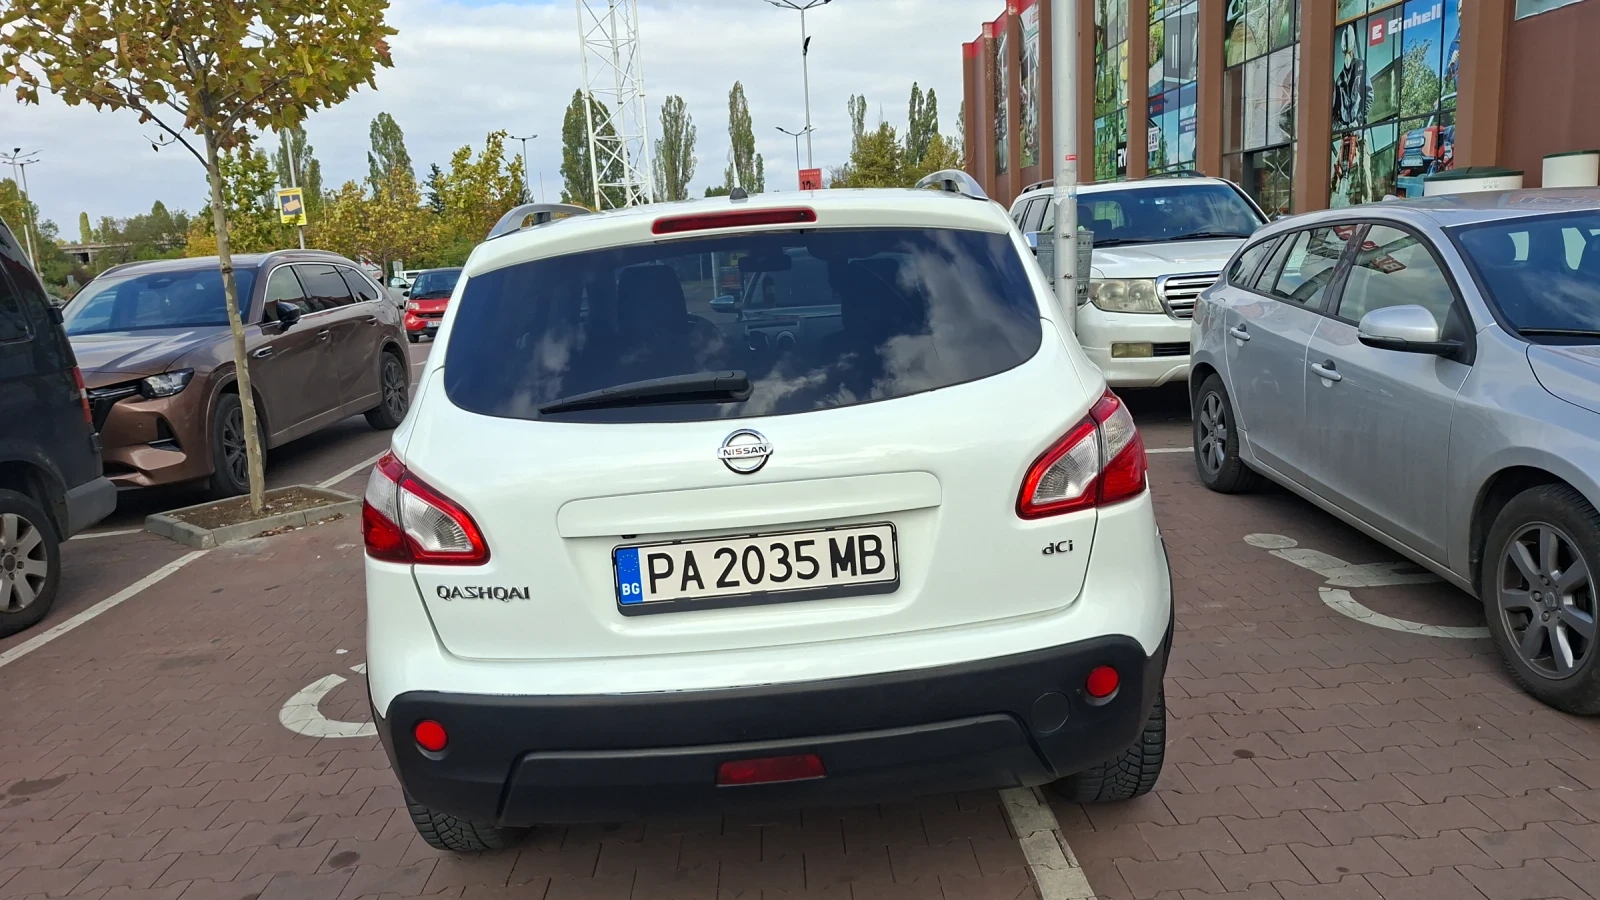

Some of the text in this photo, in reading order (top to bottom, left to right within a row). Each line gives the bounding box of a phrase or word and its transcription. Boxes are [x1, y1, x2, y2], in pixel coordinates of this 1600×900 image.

[1388, 3, 1442, 35] Einhell
[723, 446, 767, 456] NISSAN
[1042, 539, 1073, 555] dCi
[647, 534, 886, 594] PA 2035 MB
[436, 585, 530, 602] QASHQAI
[622, 583, 640, 596] BG
